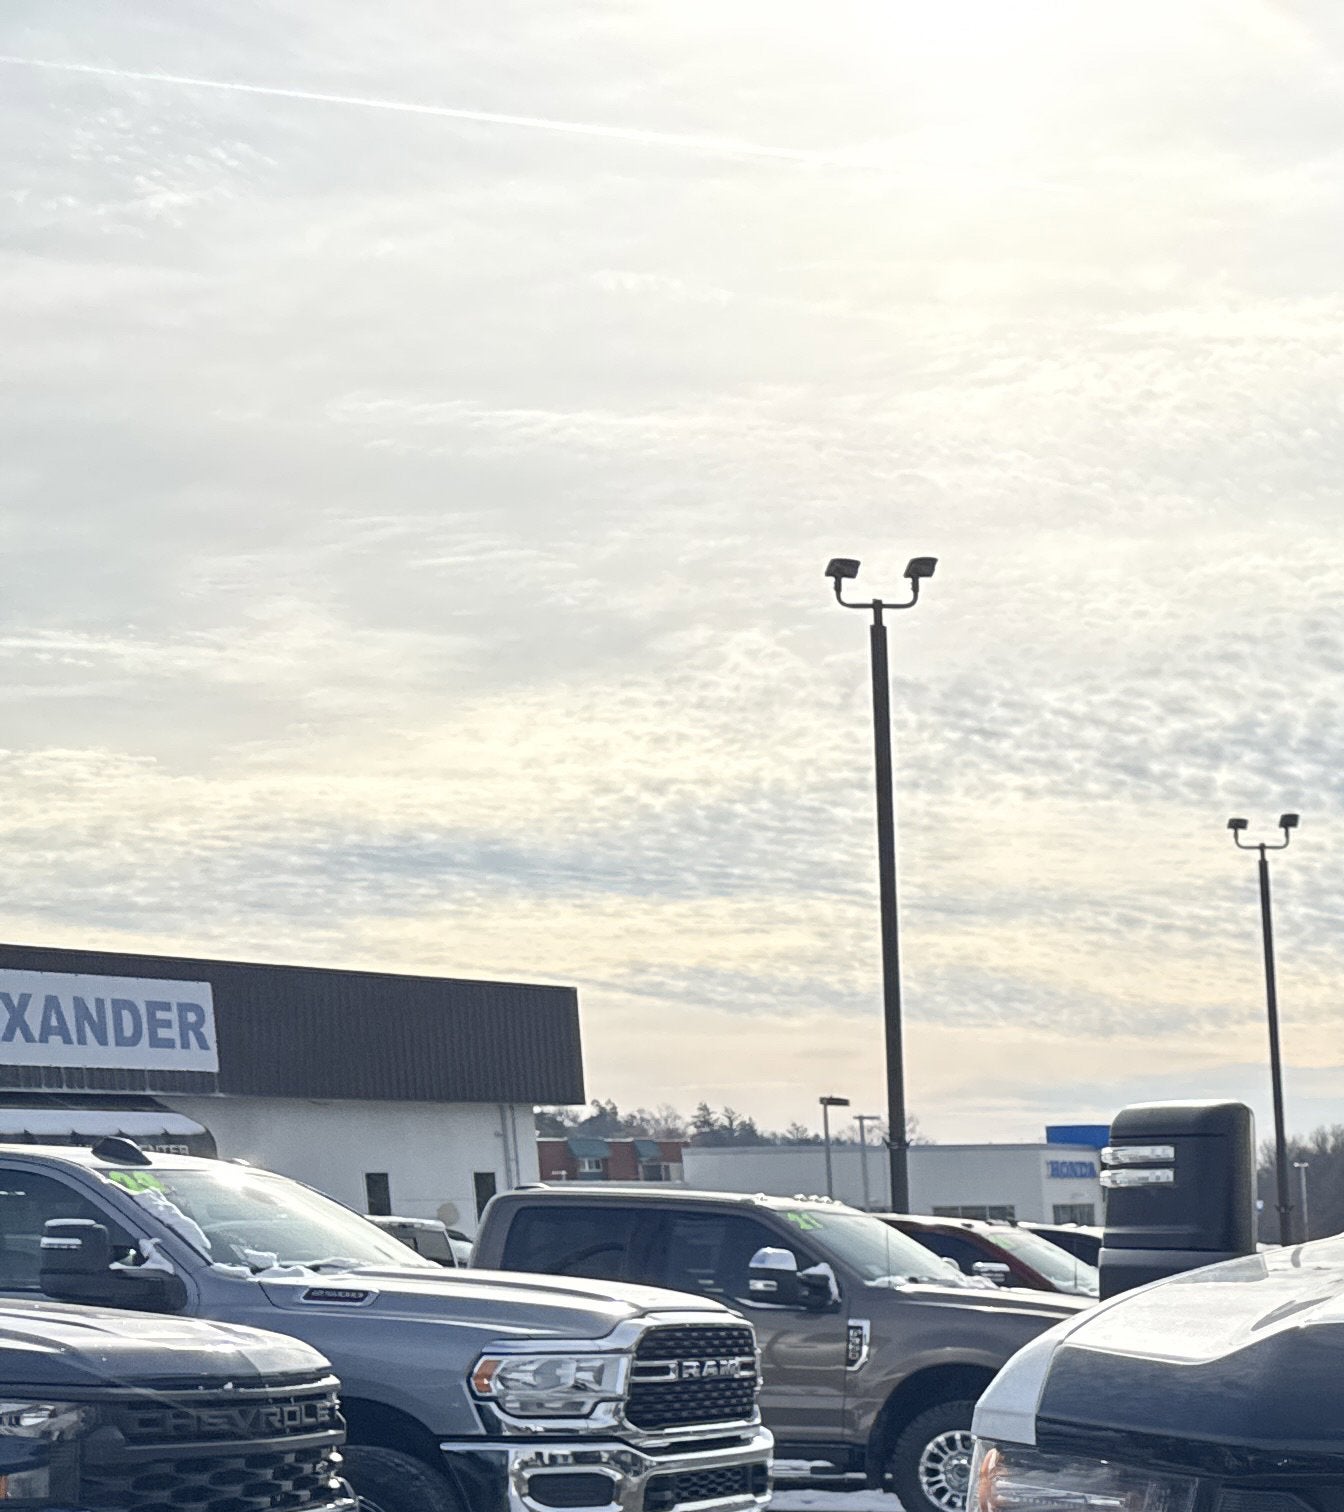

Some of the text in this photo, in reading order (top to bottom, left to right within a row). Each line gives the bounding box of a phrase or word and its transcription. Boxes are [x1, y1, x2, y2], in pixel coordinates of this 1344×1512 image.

[0, 991, 211, 1051] XANDER
[1047, 1160, 1097, 1179] HONDA
[681, 1358, 738, 1379] RAM
[129, 1400, 332, 1433] CHEVROLE
